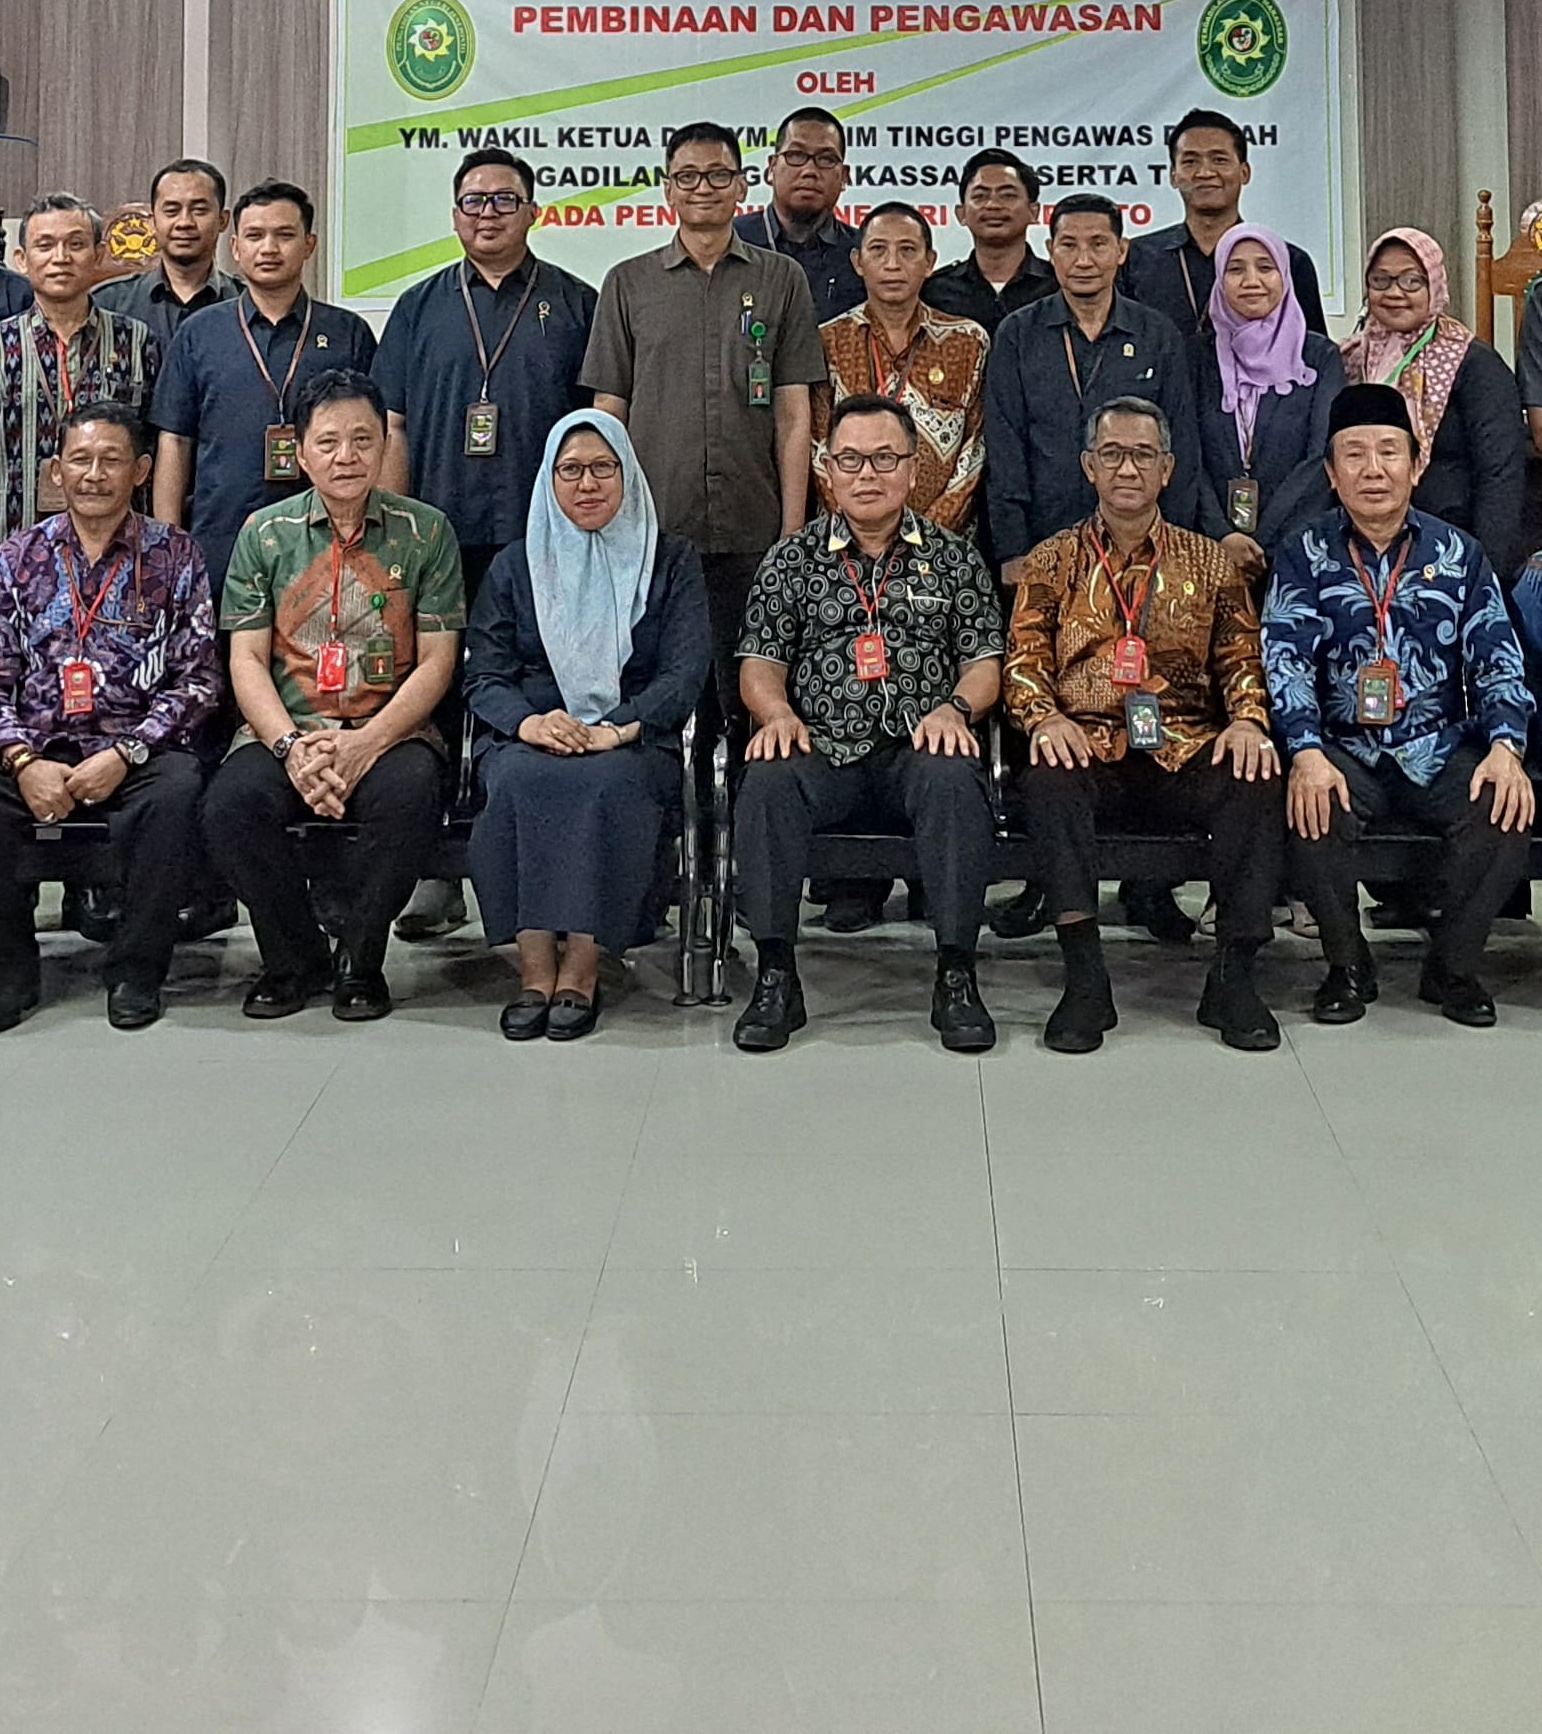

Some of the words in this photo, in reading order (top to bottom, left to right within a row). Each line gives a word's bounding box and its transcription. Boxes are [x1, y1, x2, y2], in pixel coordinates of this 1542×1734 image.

[512, 5, 757, 34] PEMBINAAN
[772, 5, 855, 33] DAN
[869, 3, 1162, 33] PENGAWASAN
[796, 71, 875, 94] OLEH
[398, 127, 448, 149] YM.
[457, 127, 548, 148] WAKIL
[558, 126, 652, 148] KETUA
[886, 125, 984, 148] TINGGI
[995, 125, 1153, 147] PENGAWAS
[536, 166, 669, 187] GADILAN
[846, 165, 959, 187] KASSA
[1038, 164, 1138, 186] SERTA
[834, 204, 947, 226] NERI
